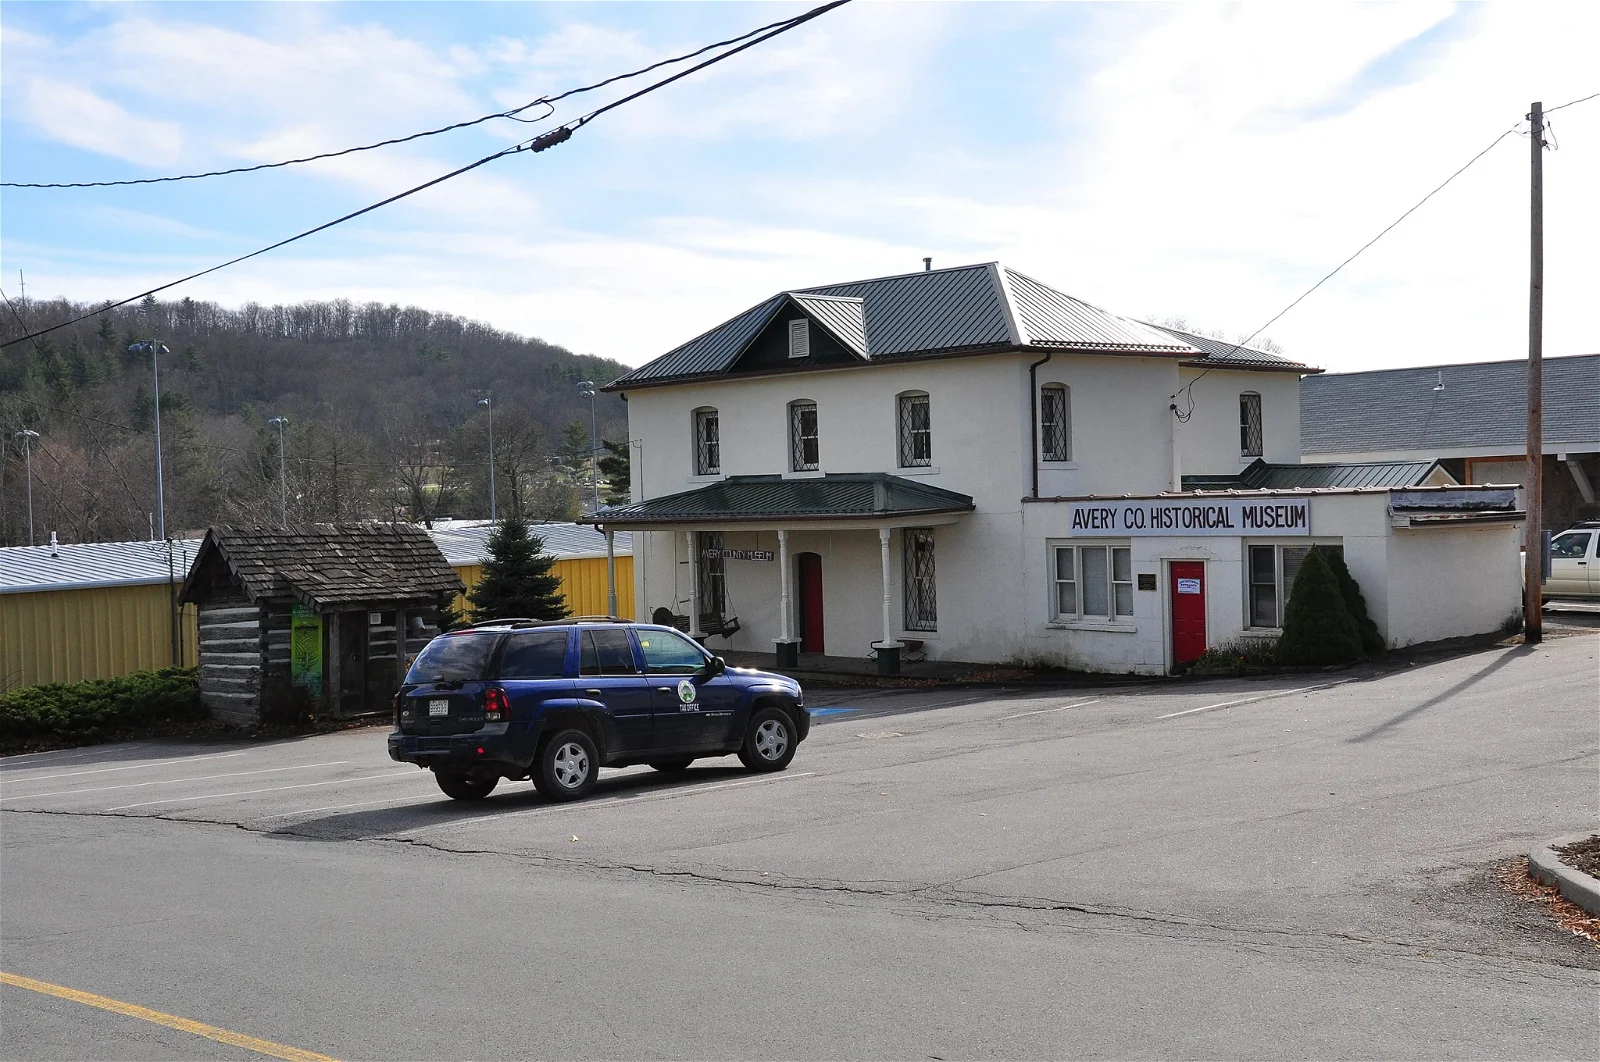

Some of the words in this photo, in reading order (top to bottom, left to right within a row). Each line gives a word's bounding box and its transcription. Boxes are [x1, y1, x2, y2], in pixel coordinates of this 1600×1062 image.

[1072, 508, 1117, 529] AVERY
[1124, 507, 1147, 529] CO.
[1151, 506, 1234, 529] HISTORICAL
[1242, 505, 1306, 528] MUSEUM
[702, 549, 720, 558] AVERY
[723, 550, 745, 559] COUNTY
[748, 551, 772, 561] MUSEUM
[687, 703, 700, 711] OFFICE
